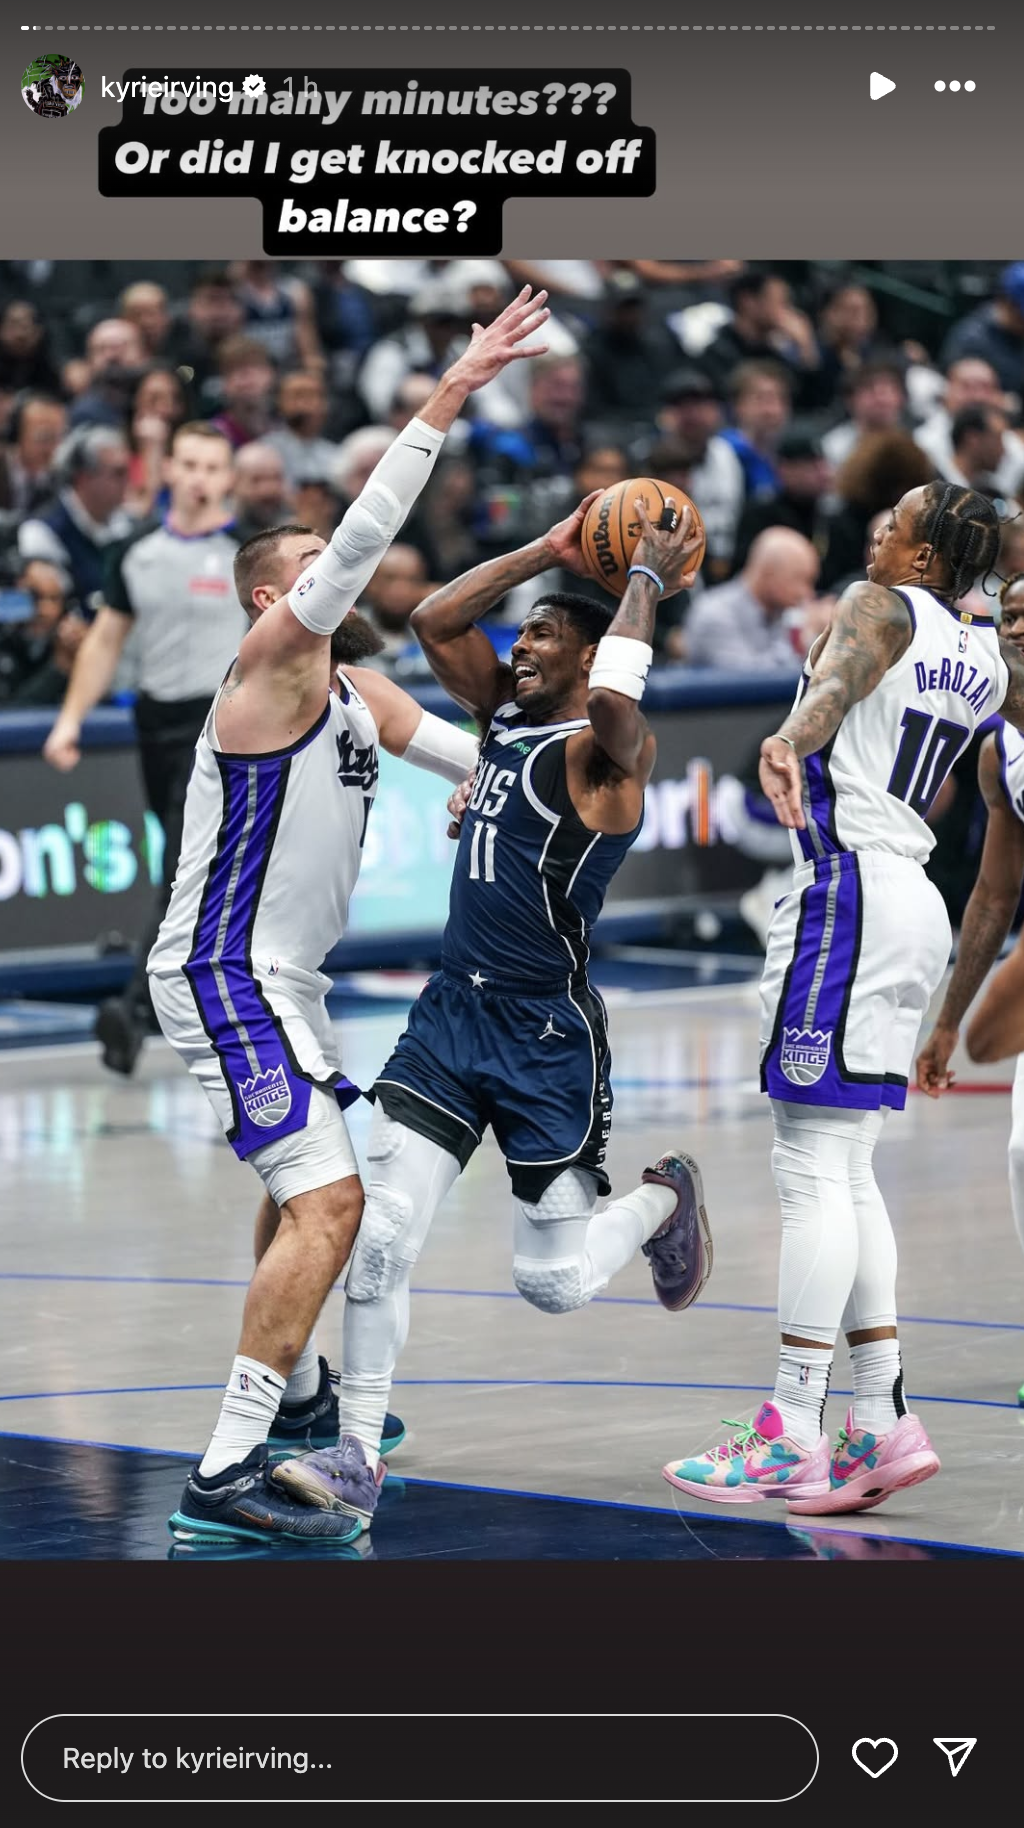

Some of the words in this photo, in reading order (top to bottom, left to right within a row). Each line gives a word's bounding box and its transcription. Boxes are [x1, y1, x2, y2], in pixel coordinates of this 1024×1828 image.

[592, 494, 618, 577] Wilson
[886, 707, 970, 820] 10
[469, 820, 498, 882] 11
[783, 1050, 828, 1065] KINGS
[246, 1087, 289, 1112] KINGS
